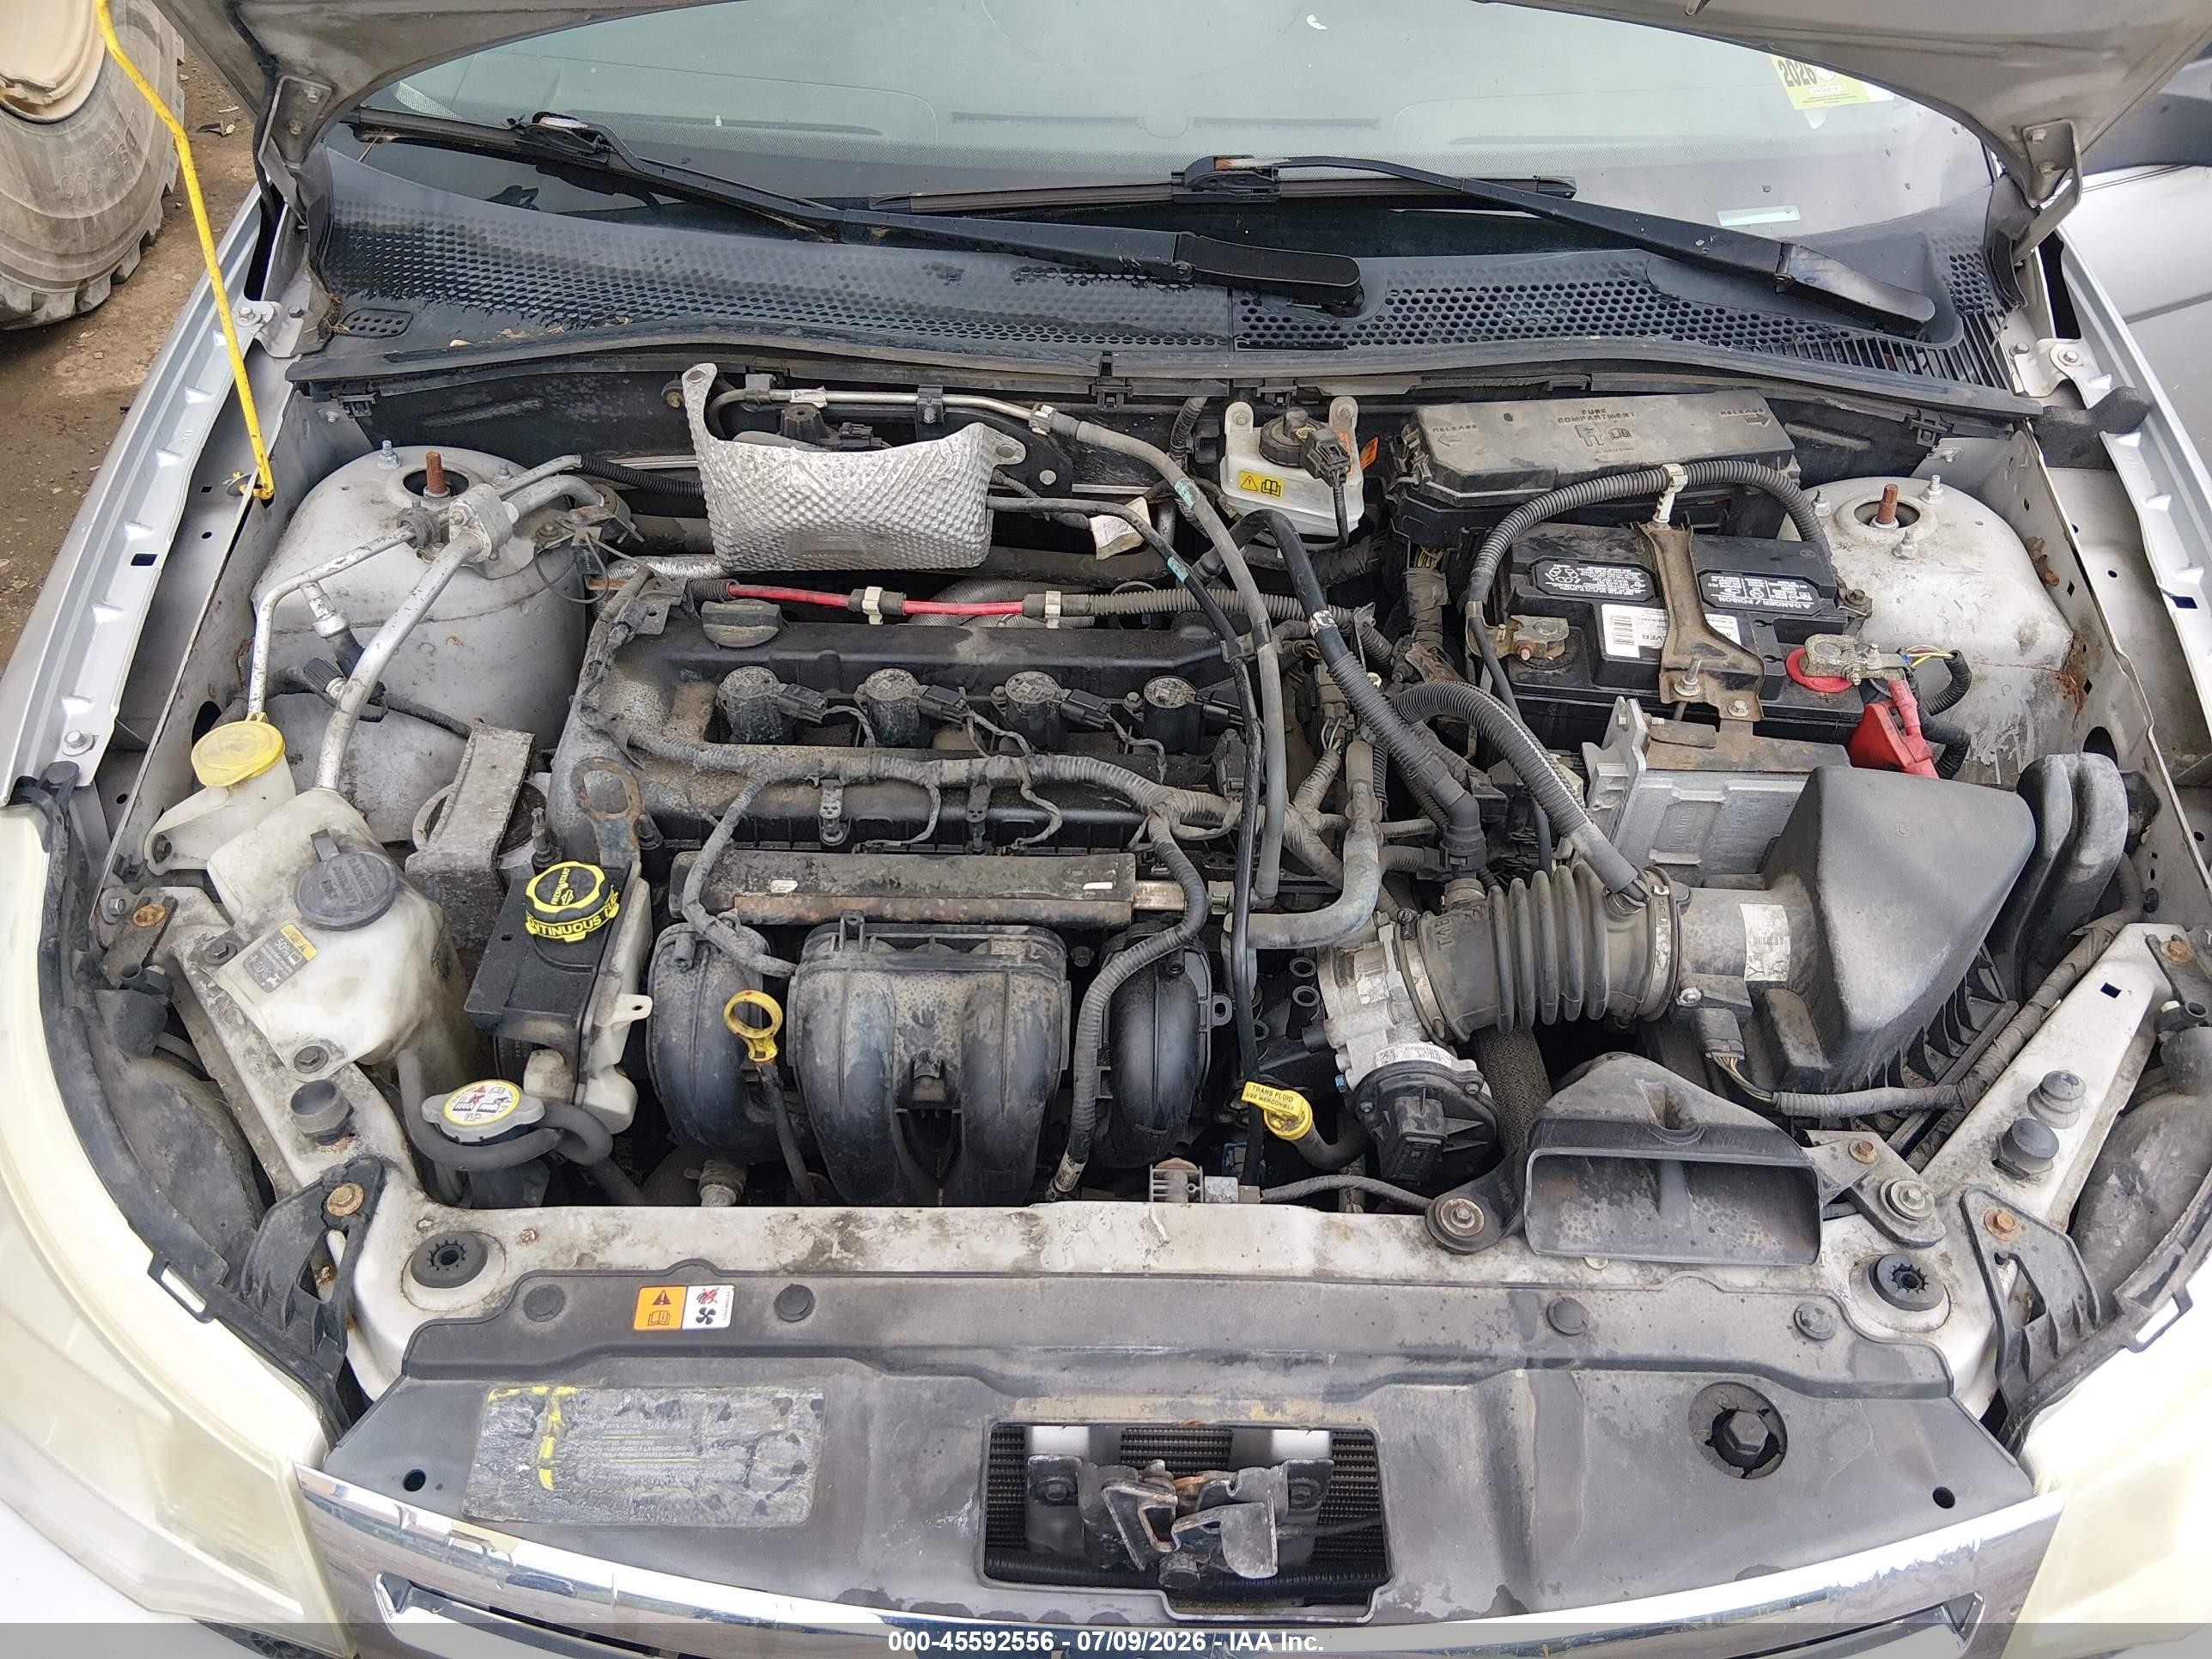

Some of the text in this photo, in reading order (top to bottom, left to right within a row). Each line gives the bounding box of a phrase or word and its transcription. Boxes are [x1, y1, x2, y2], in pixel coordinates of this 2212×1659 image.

[1778, 59, 1818, 88] 2026
[1557, 412, 1636, 424] COMPARTMENT
[1432, 423, 1478, 434] RELEASE
[1718, 596, 1753, 605] POISON
[1763, 599, 1802, 609] DANGER
[526, 915, 602, 937] ONTINUOUS
[1251, 1085, 1294, 1103] TRANS FLUID
